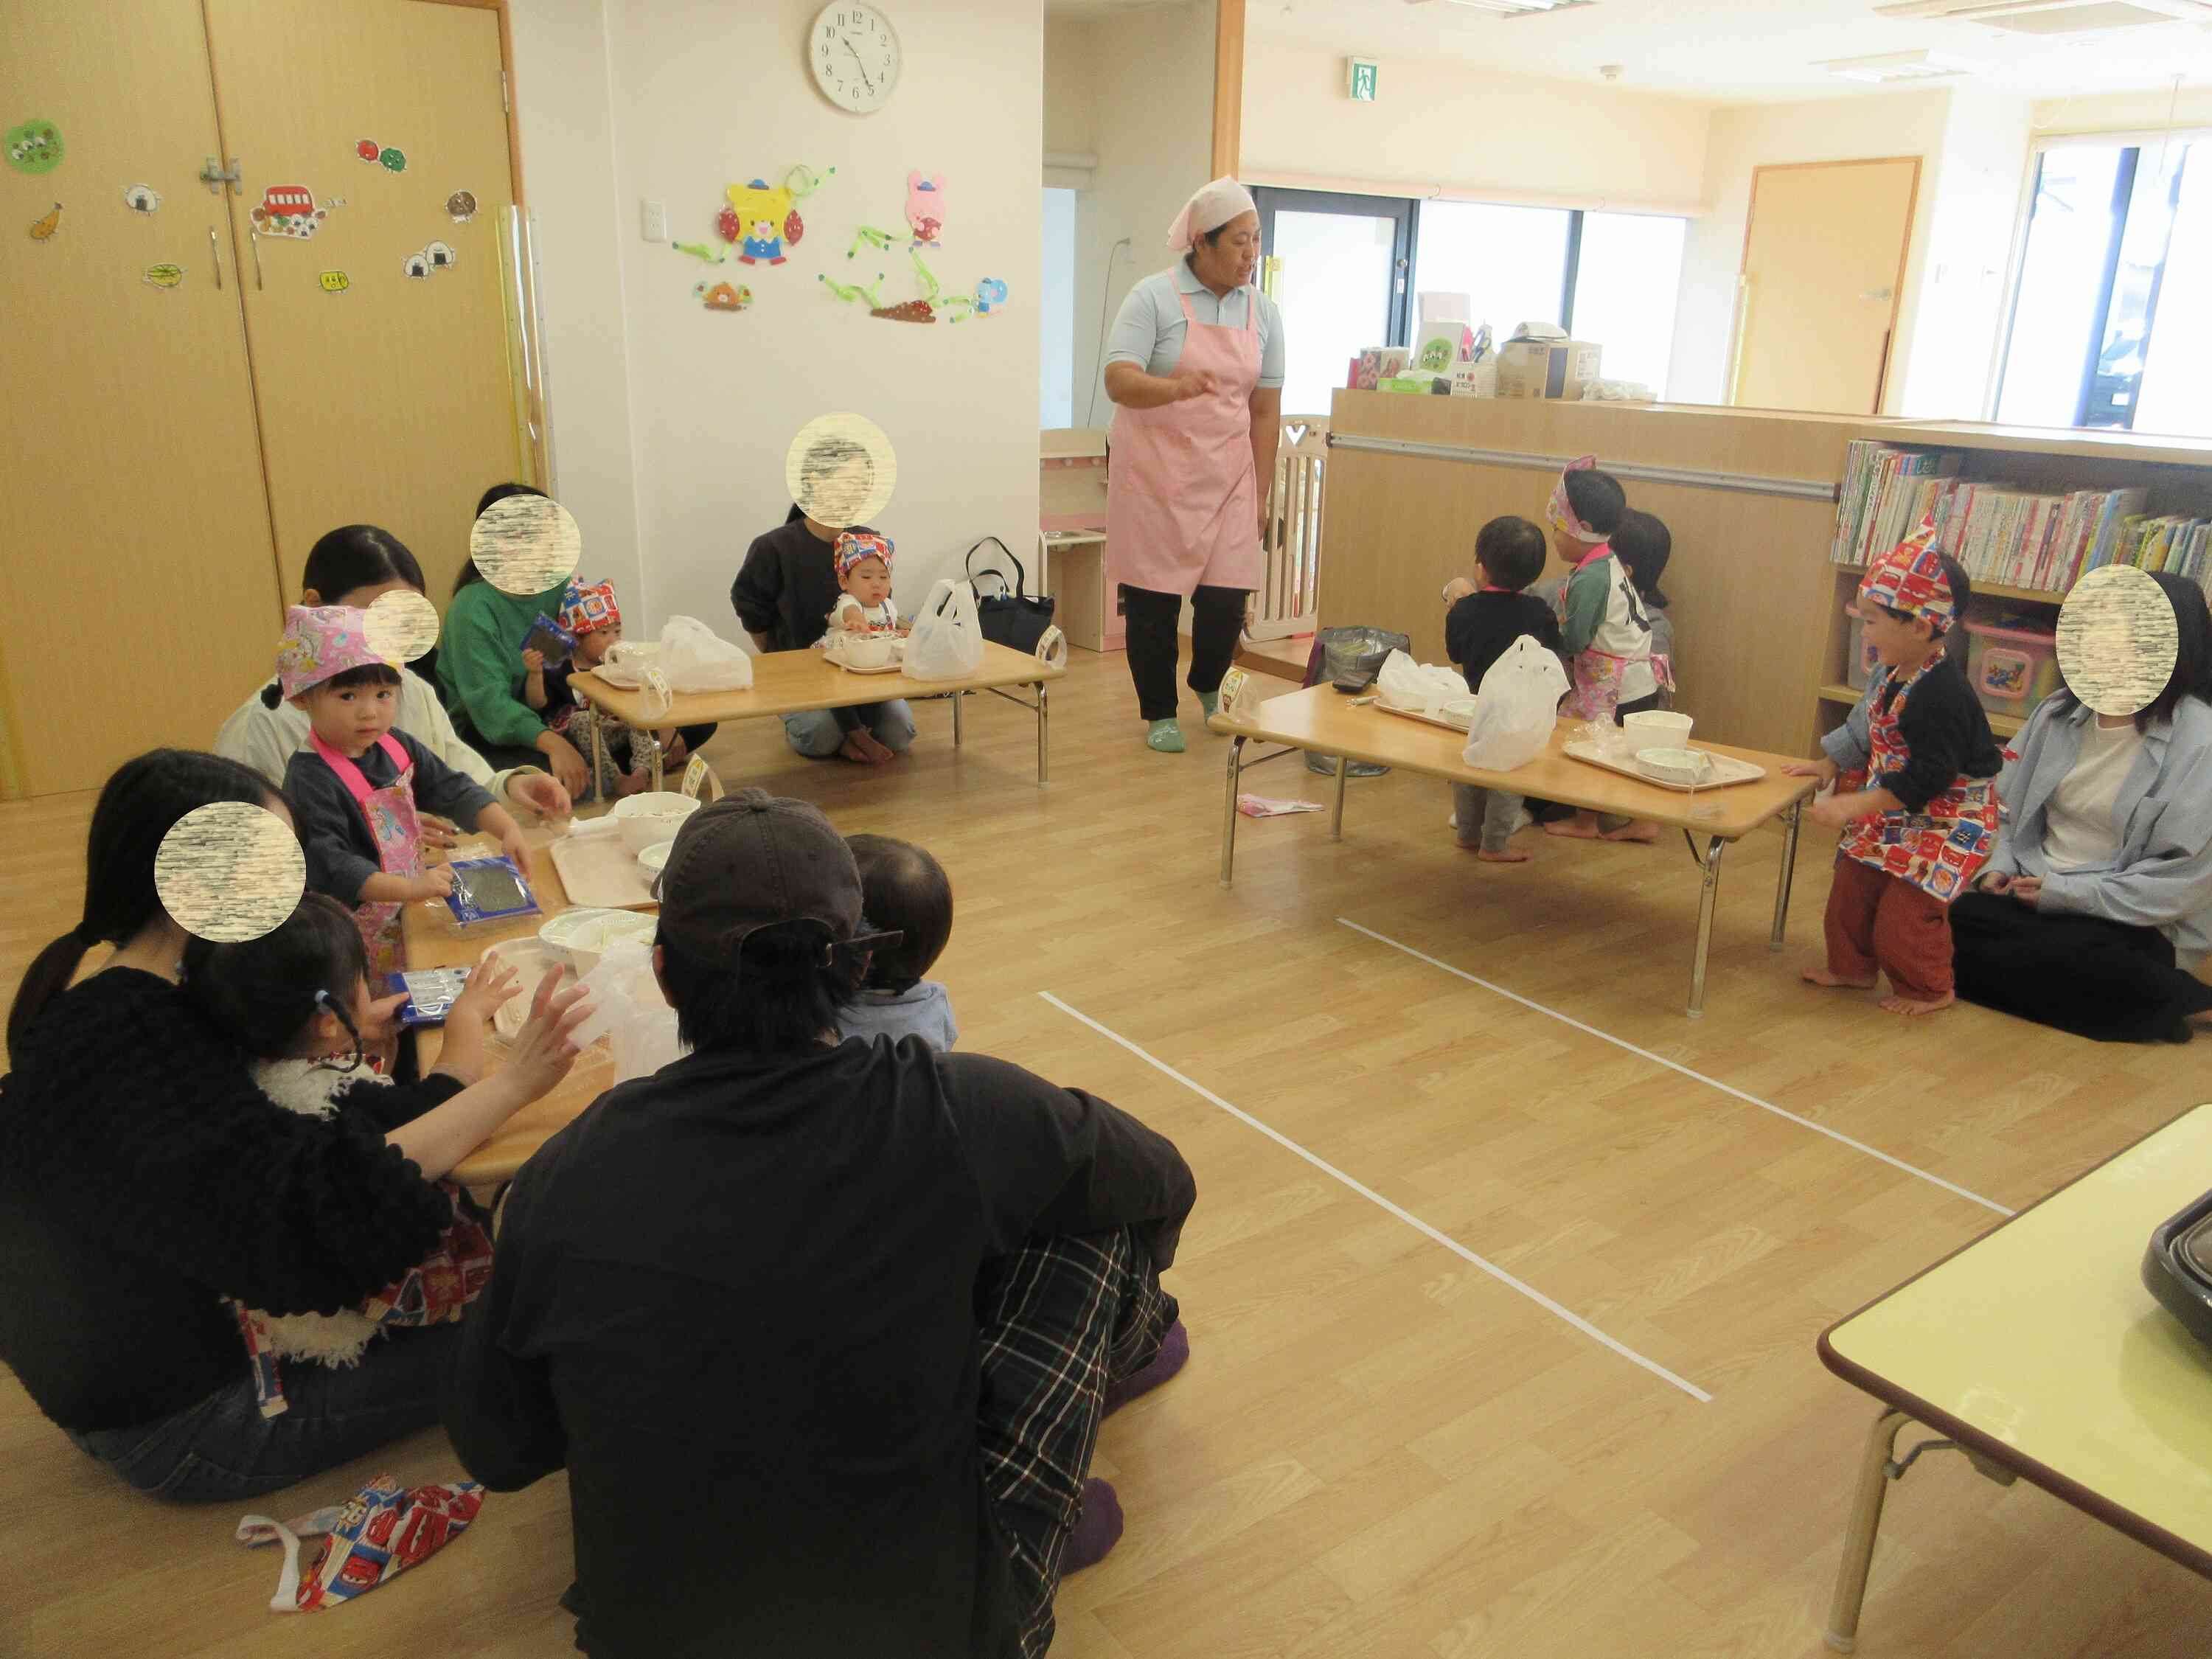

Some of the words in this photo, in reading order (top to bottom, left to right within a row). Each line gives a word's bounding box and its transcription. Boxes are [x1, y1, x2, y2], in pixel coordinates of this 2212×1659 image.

[838, 13, 844, 27] 11
[852, 11, 862, 24] 12
[826, 27, 835, 38] 10
[880, 35, 887, 47] 2
[821, 44, 829, 57] 9
[883, 54, 891, 66] 3
[826, 65, 832, 77] 8
[878, 71, 884, 83] 4
[838, 80, 844, 92] 7
[868, 85, 874, 96] 5
[852, 87, 860, 99] 6
